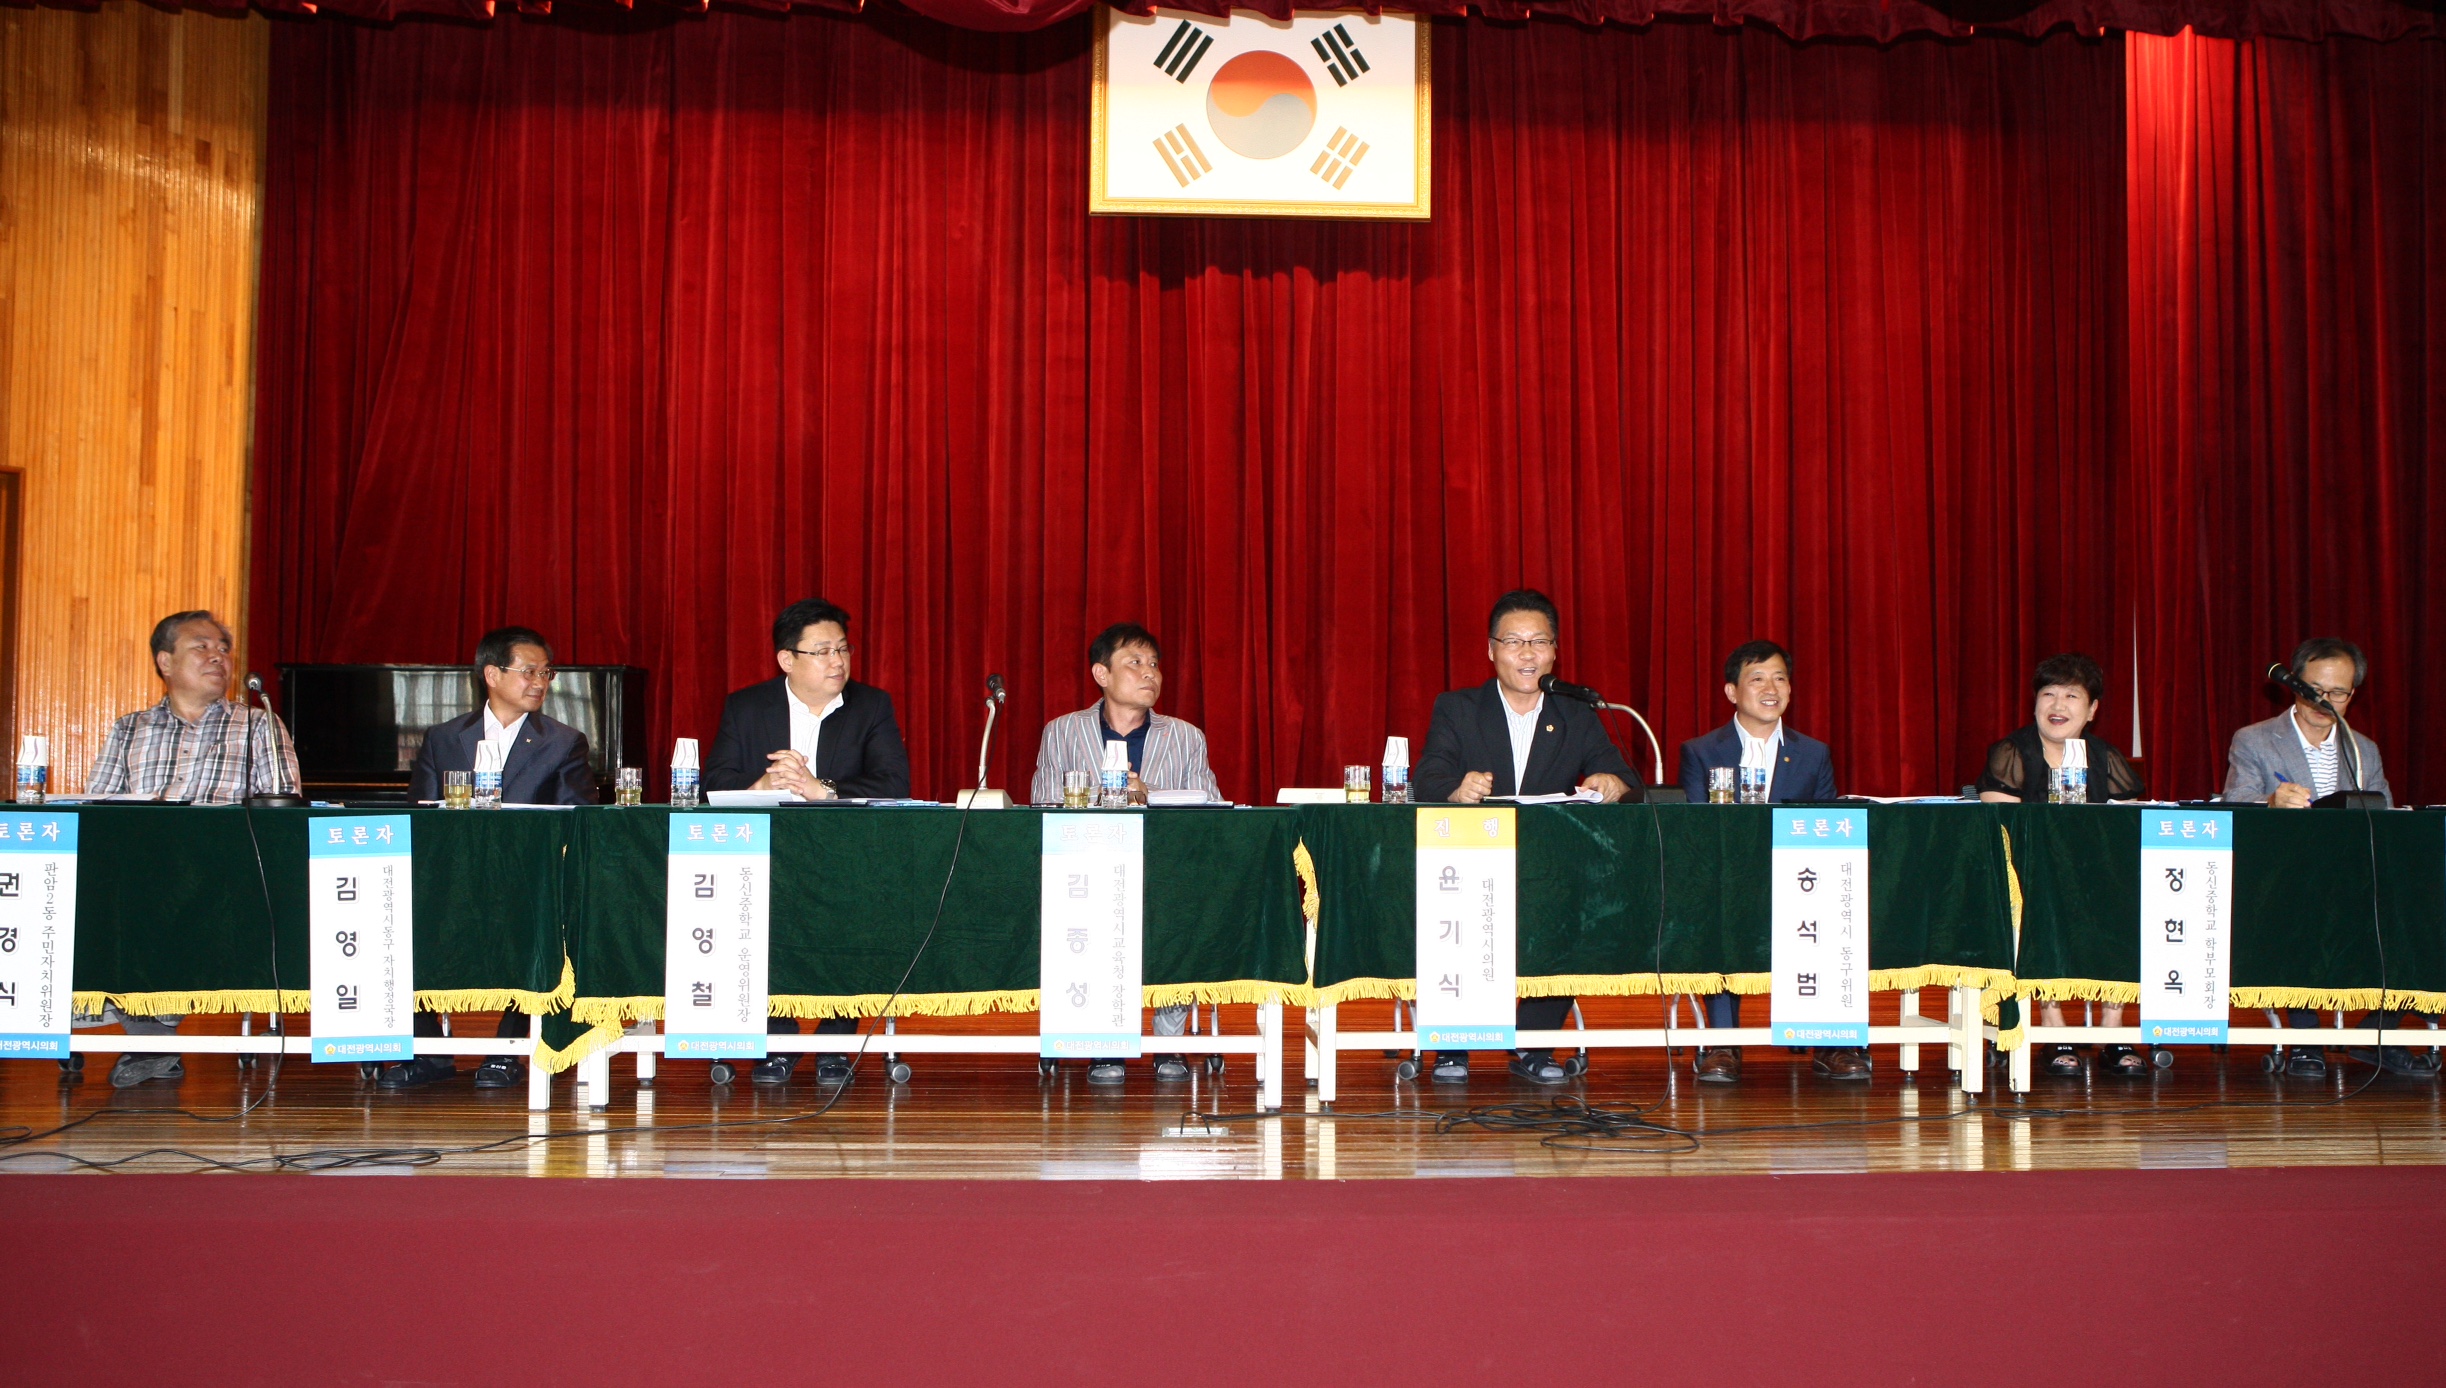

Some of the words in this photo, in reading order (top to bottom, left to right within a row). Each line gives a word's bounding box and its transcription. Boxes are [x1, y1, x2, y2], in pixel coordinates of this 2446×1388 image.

[327, 824, 394, 845] 토론자
[687, 823, 753, 843] 토론자
[1061, 823, 1128, 844] 토론자
[1790, 818, 1853, 838] 토론자
[2158, 820, 2218, 840] 토론자
[42, 862, 58, 921] 판암2동
[382, 865, 395, 951] 대전광역시동구
[738, 866, 753, 940] 동신중학교
[1112, 863, 1126, 980] 대전광역시교육청
[1840, 861, 1852, 939] 대전광역시
[2205, 861, 2218, 931] 동신중학교
[336, 877, 357, 1010] 김영일
[691, 873, 715, 1007] 김영철
[1066, 874, 1089, 1008] 김종성
[1438, 865, 1460, 998] 윤기식
[1481, 877, 1496, 982] 대전광역시의원
[1797, 867, 1817, 996] 송석범
[2164, 868, 2184, 995] 정현옥
[39, 926, 56, 1028] 주민자치위원장
[383, 954, 396, 1029] 자치행정국장
[737, 947, 752, 1023] 운영위원장
[1111, 983, 1125, 1027] 장학관
[1840, 946, 1853, 1008] 동구위원
[2203, 937, 2217, 1010] 학부모회장
[338, 1042, 402, 1055] 대전광역시의회
[690, 1040, 755, 1051] 대전광역시의회
[1066, 1040, 1130, 1051] 대전광역시의회
[1441, 1031, 1503, 1043] 대전광역시의회
[1796, 1028, 1858, 1040] 대전광역시의회
[2163, 1026, 2219, 1037] 대전광역시의회
